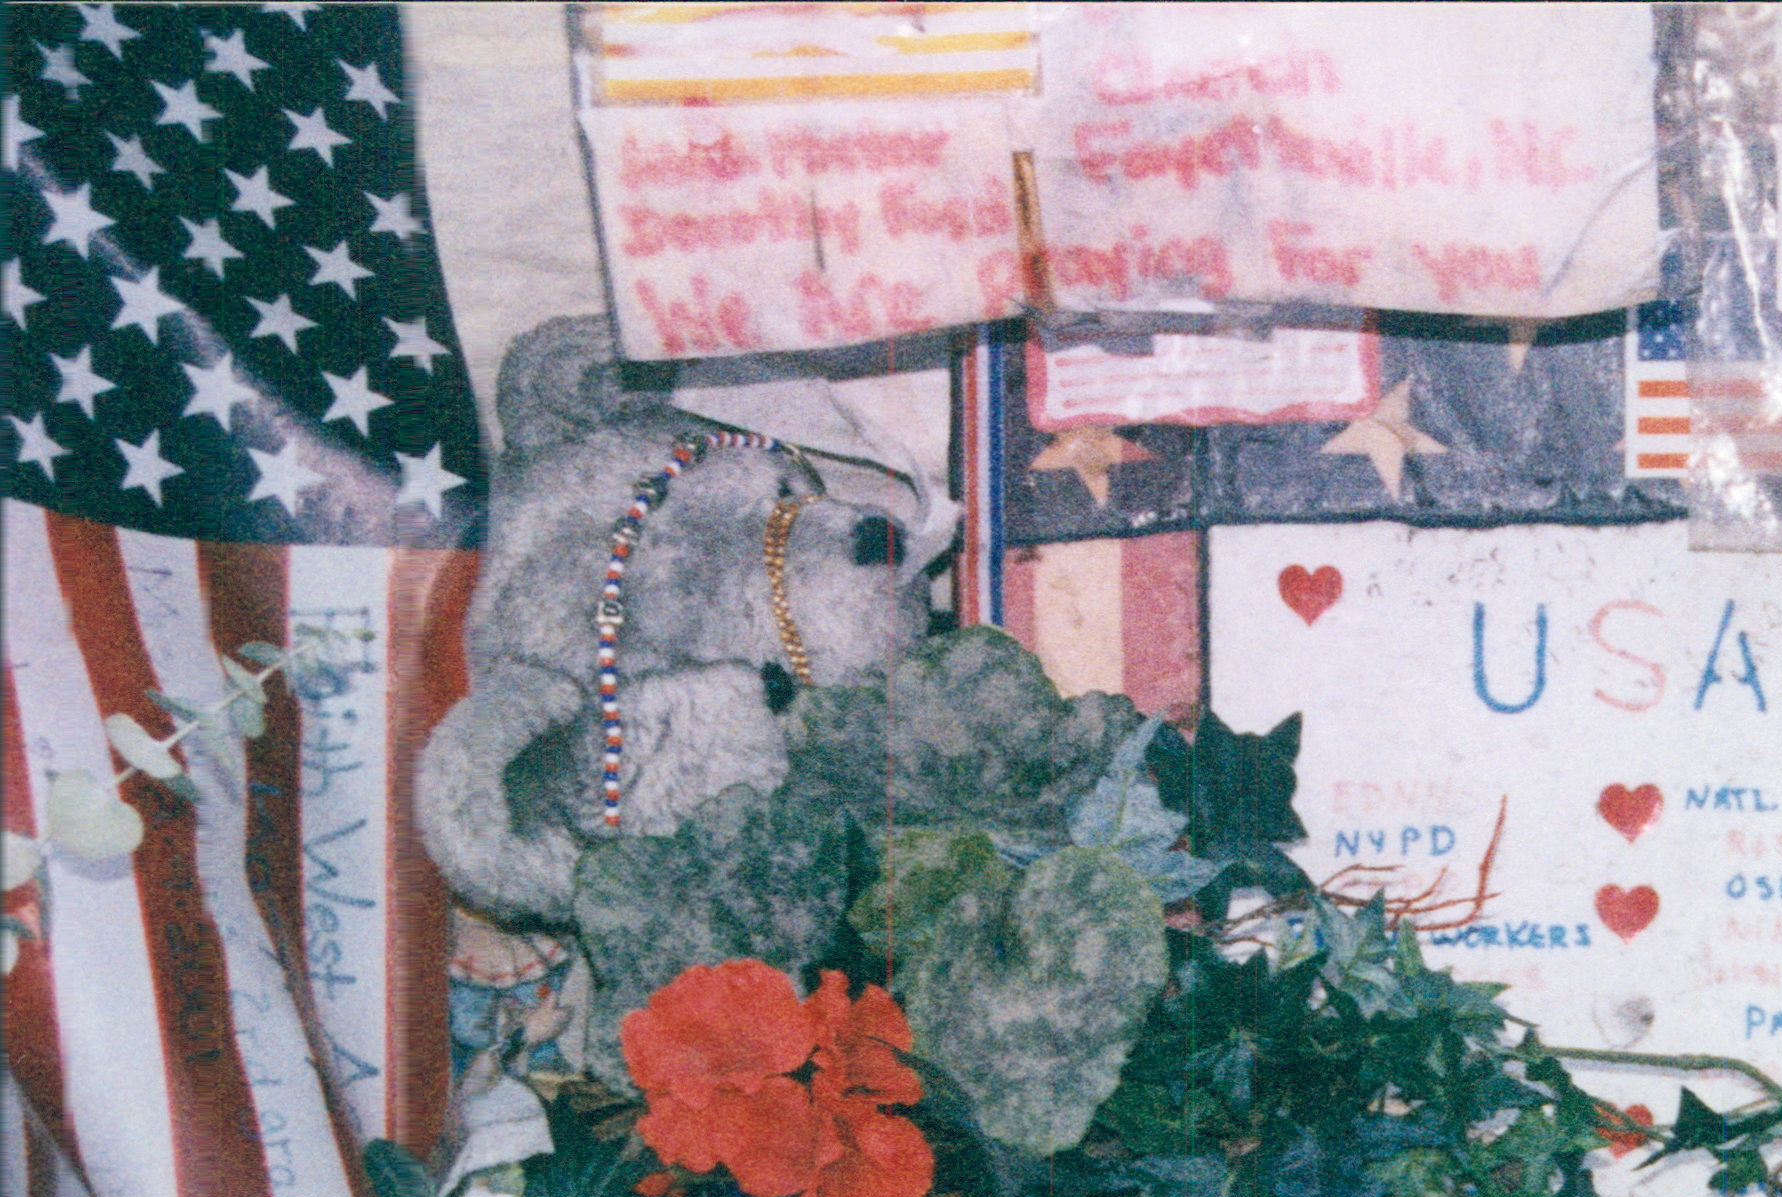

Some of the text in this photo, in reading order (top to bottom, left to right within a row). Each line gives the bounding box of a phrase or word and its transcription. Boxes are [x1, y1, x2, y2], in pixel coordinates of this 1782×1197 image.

[1472, 598, 1768, 715] USA
[1333, 823, 1458, 859] NYPD
[302, 818, 379, 1000] West
